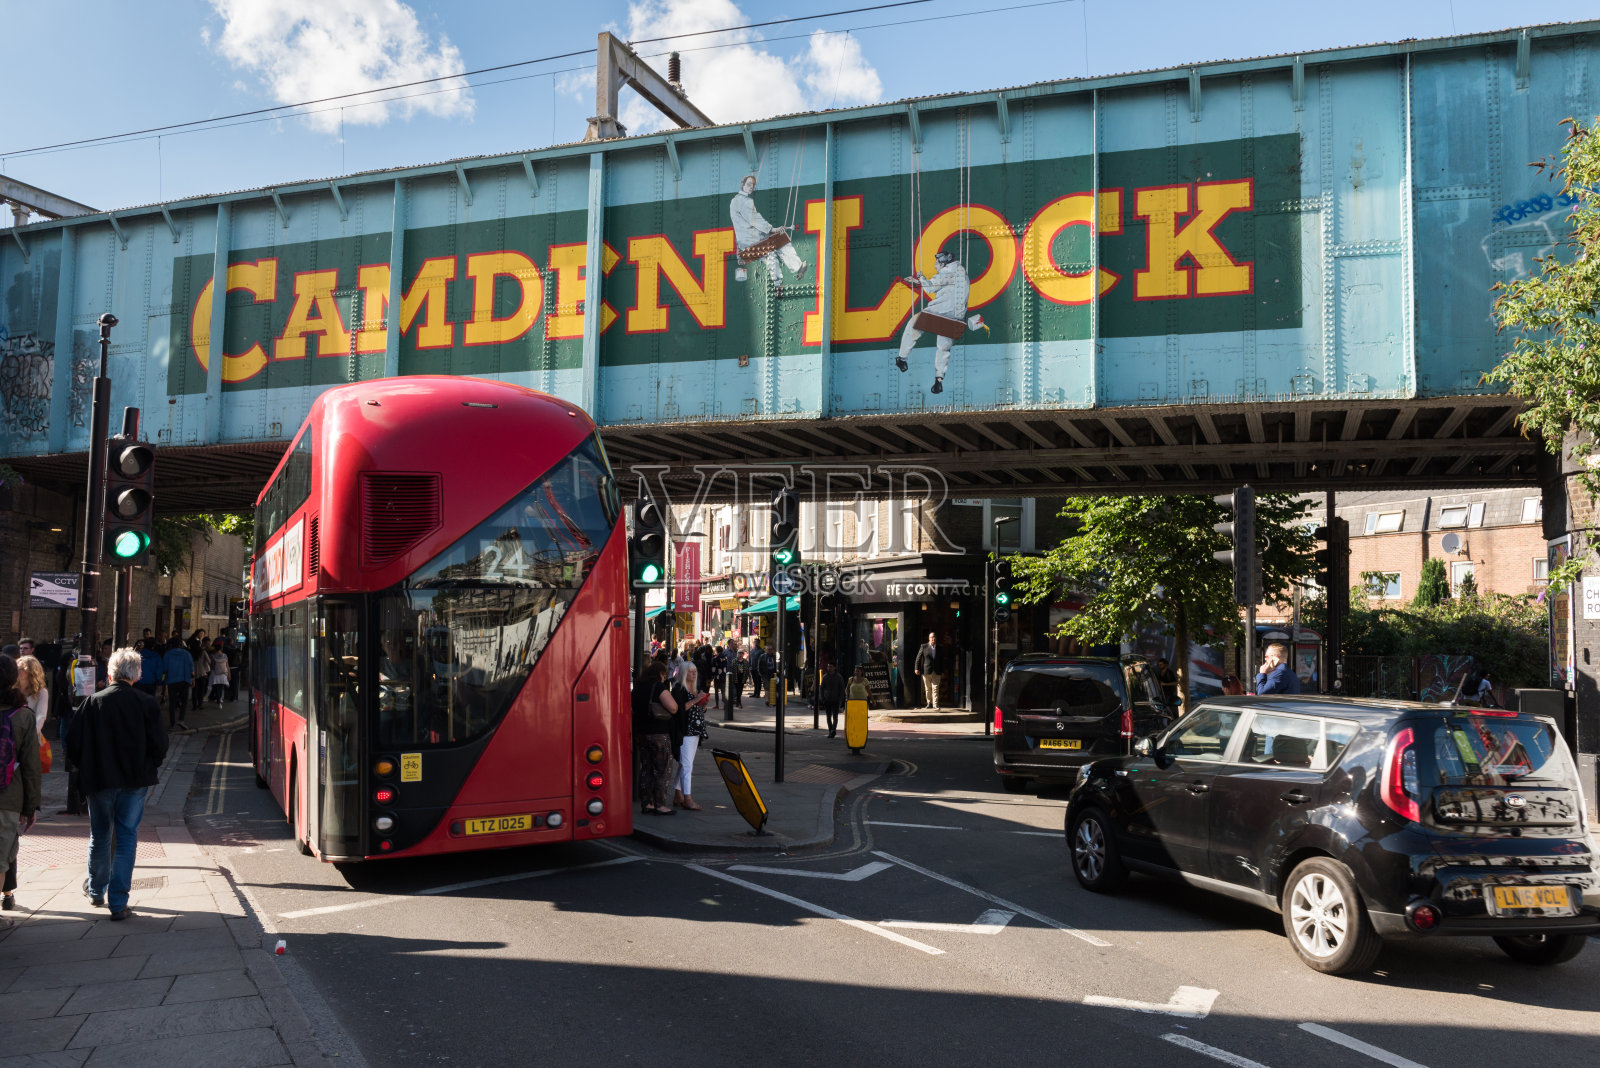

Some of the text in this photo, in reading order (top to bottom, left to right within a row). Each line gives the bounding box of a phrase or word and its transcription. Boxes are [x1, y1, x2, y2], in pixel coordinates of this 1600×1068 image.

[192, 177, 1254, 384] CAMDEN LOCK
[484, 545, 530, 578] 24
[886, 583, 987, 596] EYE CONTACTS
[1063, 739, 1078, 748] SYT
[472, 816, 525, 833] LTZ 1025
[1503, 887, 1561, 906] LN16 VCL
